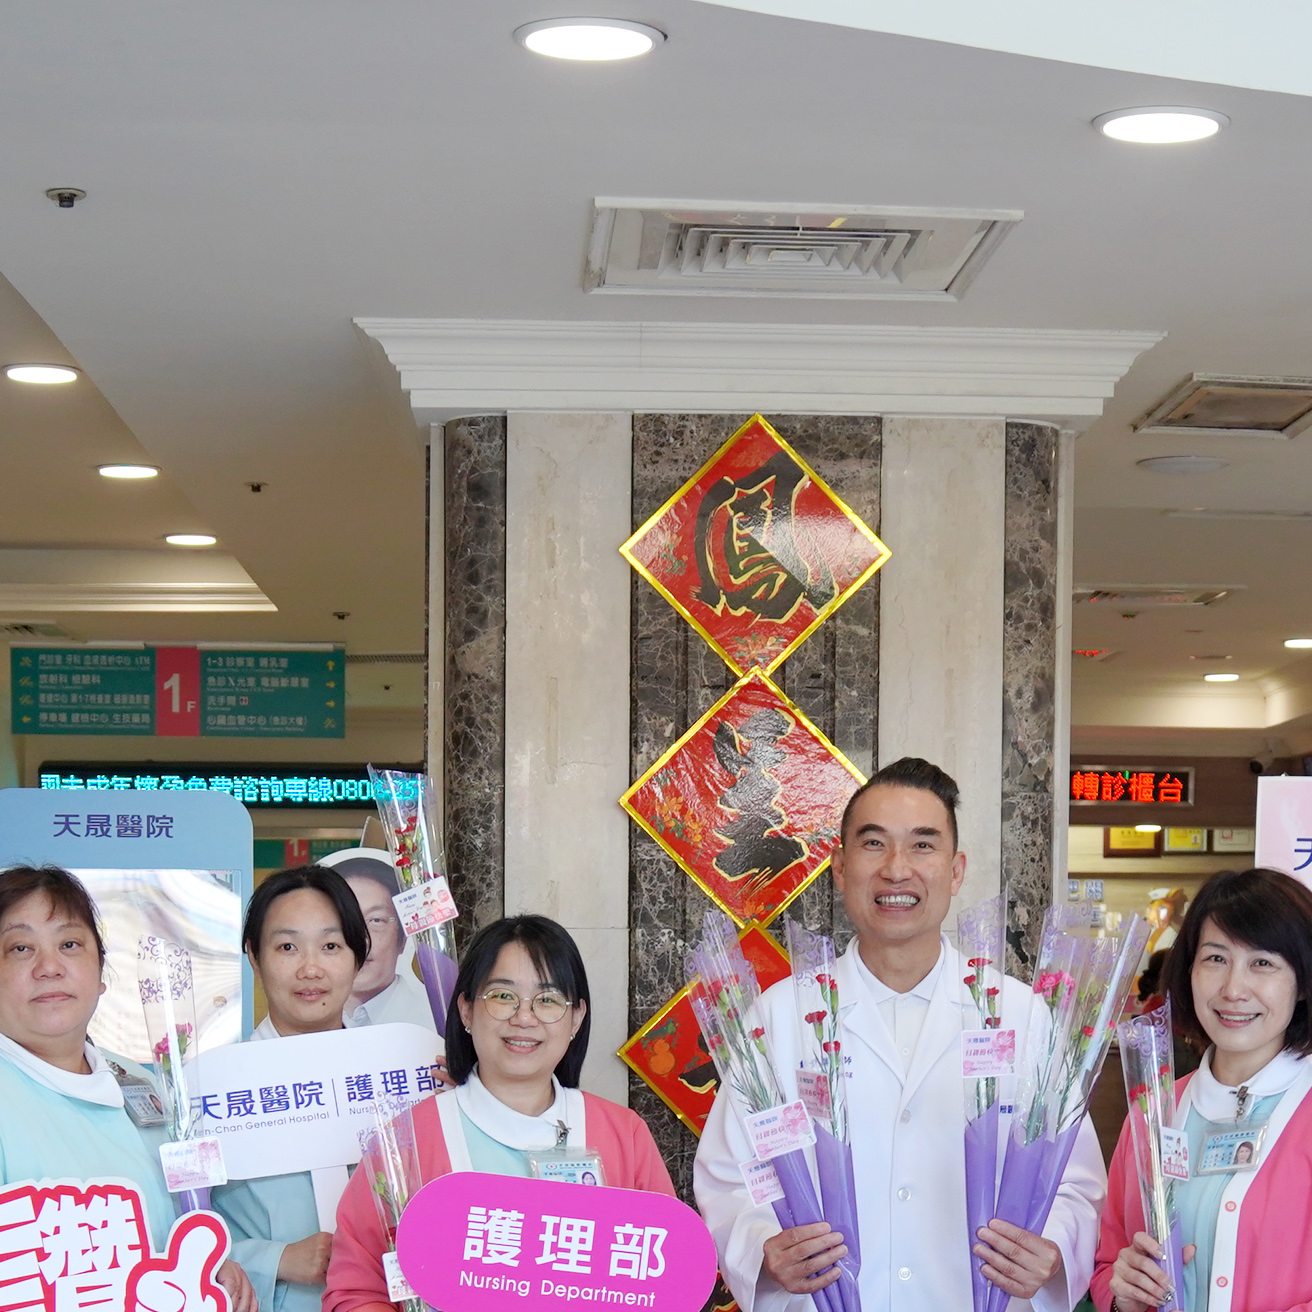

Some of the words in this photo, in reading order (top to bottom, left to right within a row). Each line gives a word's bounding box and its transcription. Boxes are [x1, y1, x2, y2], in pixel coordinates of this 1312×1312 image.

[1071, 770, 1184, 803] 轉診櫃台
[53, 813, 174, 839] 天晟醫院
[191, 1080, 326, 1121] 天晟醫院
[344, 1064, 445, 1103] 護理部
[245, 1118, 288, 1131] General
[288, 1110, 330, 1126] Hospital
[463, 1205, 669, 1281] 護理部
[458, 1269, 532, 1298] Nursing
[540, 1279, 657, 1308] Department
